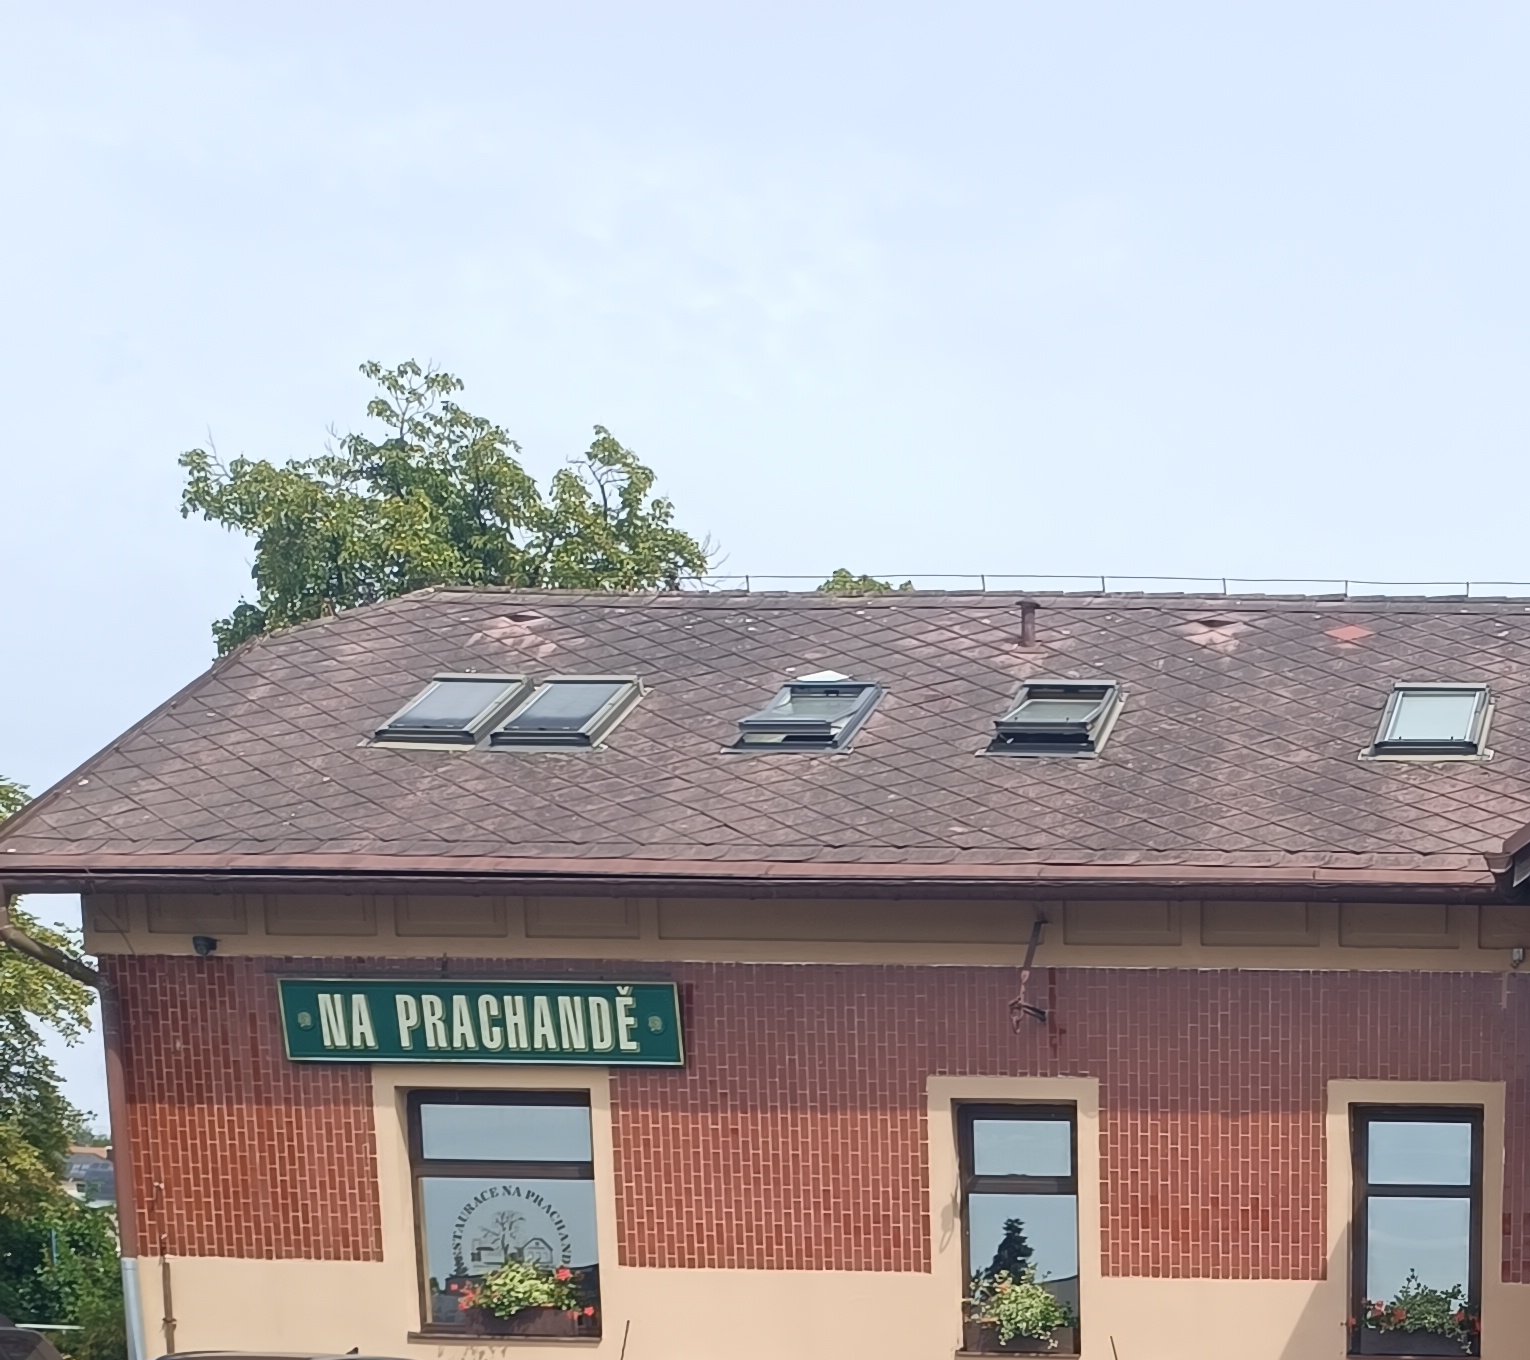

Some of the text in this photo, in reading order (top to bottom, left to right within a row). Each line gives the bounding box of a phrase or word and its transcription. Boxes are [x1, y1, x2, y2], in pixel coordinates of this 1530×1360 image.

[317, 985, 640, 1052] NA PRACHANDĚ
[501, 1185, 522, 1198] NA
[525, 1189, 572, 1265] PRACHAND
